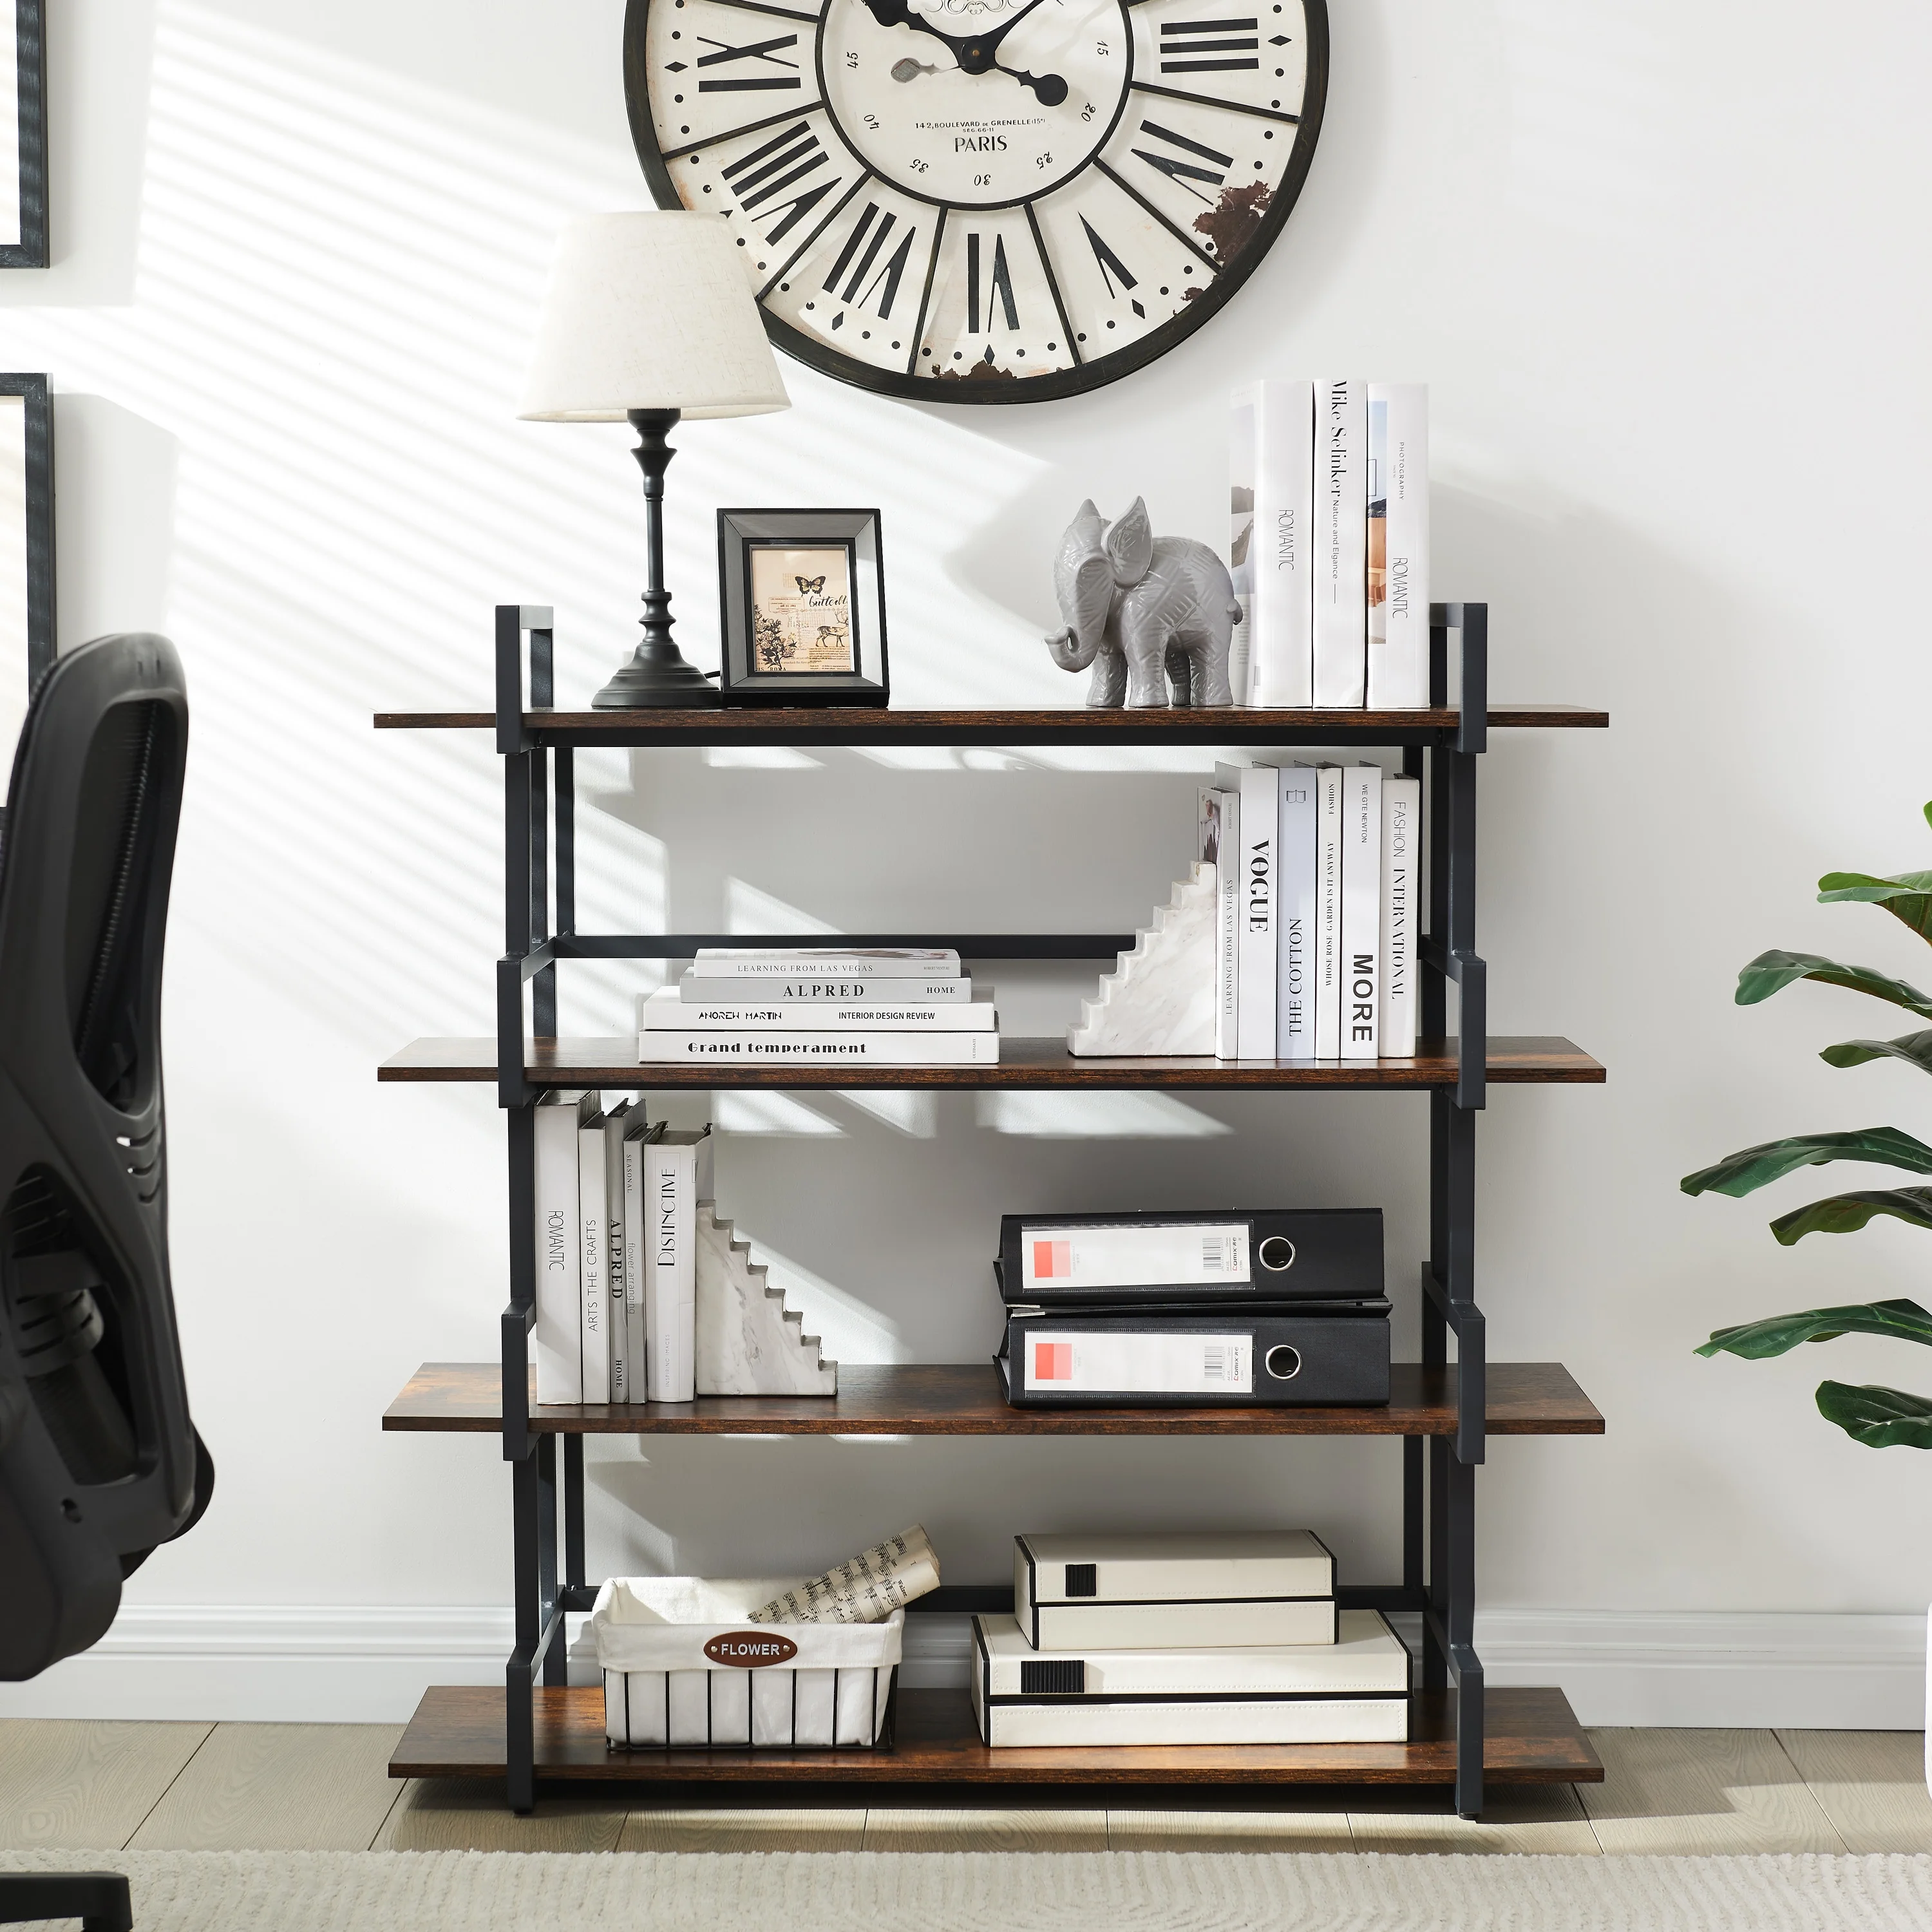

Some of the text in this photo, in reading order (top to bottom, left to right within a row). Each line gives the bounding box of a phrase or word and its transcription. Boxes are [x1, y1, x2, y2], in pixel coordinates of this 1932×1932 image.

[697, 34, 801, 92] IX
[847, 52, 858, 68] 45
[1097, 41, 1108, 55] 15
[1160, 18, 1259, 73] III
[864, 115, 879, 129] 40
[1081, 102, 1095, 122] 20
[955, 135, 1007, 152] PARIS
[1036, 151, 1054, 169] 25
[909, 158, 929, 174] 35
[974, 175, 992, 187] 30
[1078, 211, 1138, 299] V
[1331, 380, 1347, 497] Mike Selinker
[1279, 510, 1294, 570] ROMANTIC
[809, 595, 848, 607] butterfl
[1393, 558, 1408, 618] ROMANTIC
[1362, 784, 1368, 795] WE
[1249, 838, 1269, 933] VOGUE
[1392, 802, 1406, 1000] FASHION INTERNATIONAL
[783, 985, 864, 996] ALPRED
[1289, 918, 1302, 1037] THE COTTON
[1353, 955, 1373, 1041] MORE
[688, 1043, 866, 1053] Grand temperament
[658, 1169, 676, 1267] DISTINCTIVE
[549, 1211, 564, 1270] ROMANTIC
[611, 1219, 623, 1299] ALPRED
[586, 1220, 598, 1332] ARTS THE CRAFTS
[627, 1273, 636, 1314] arranging
[614, 1359, 623, 1388] HOME
[721, 1643, 781, 1656] FLOWER
